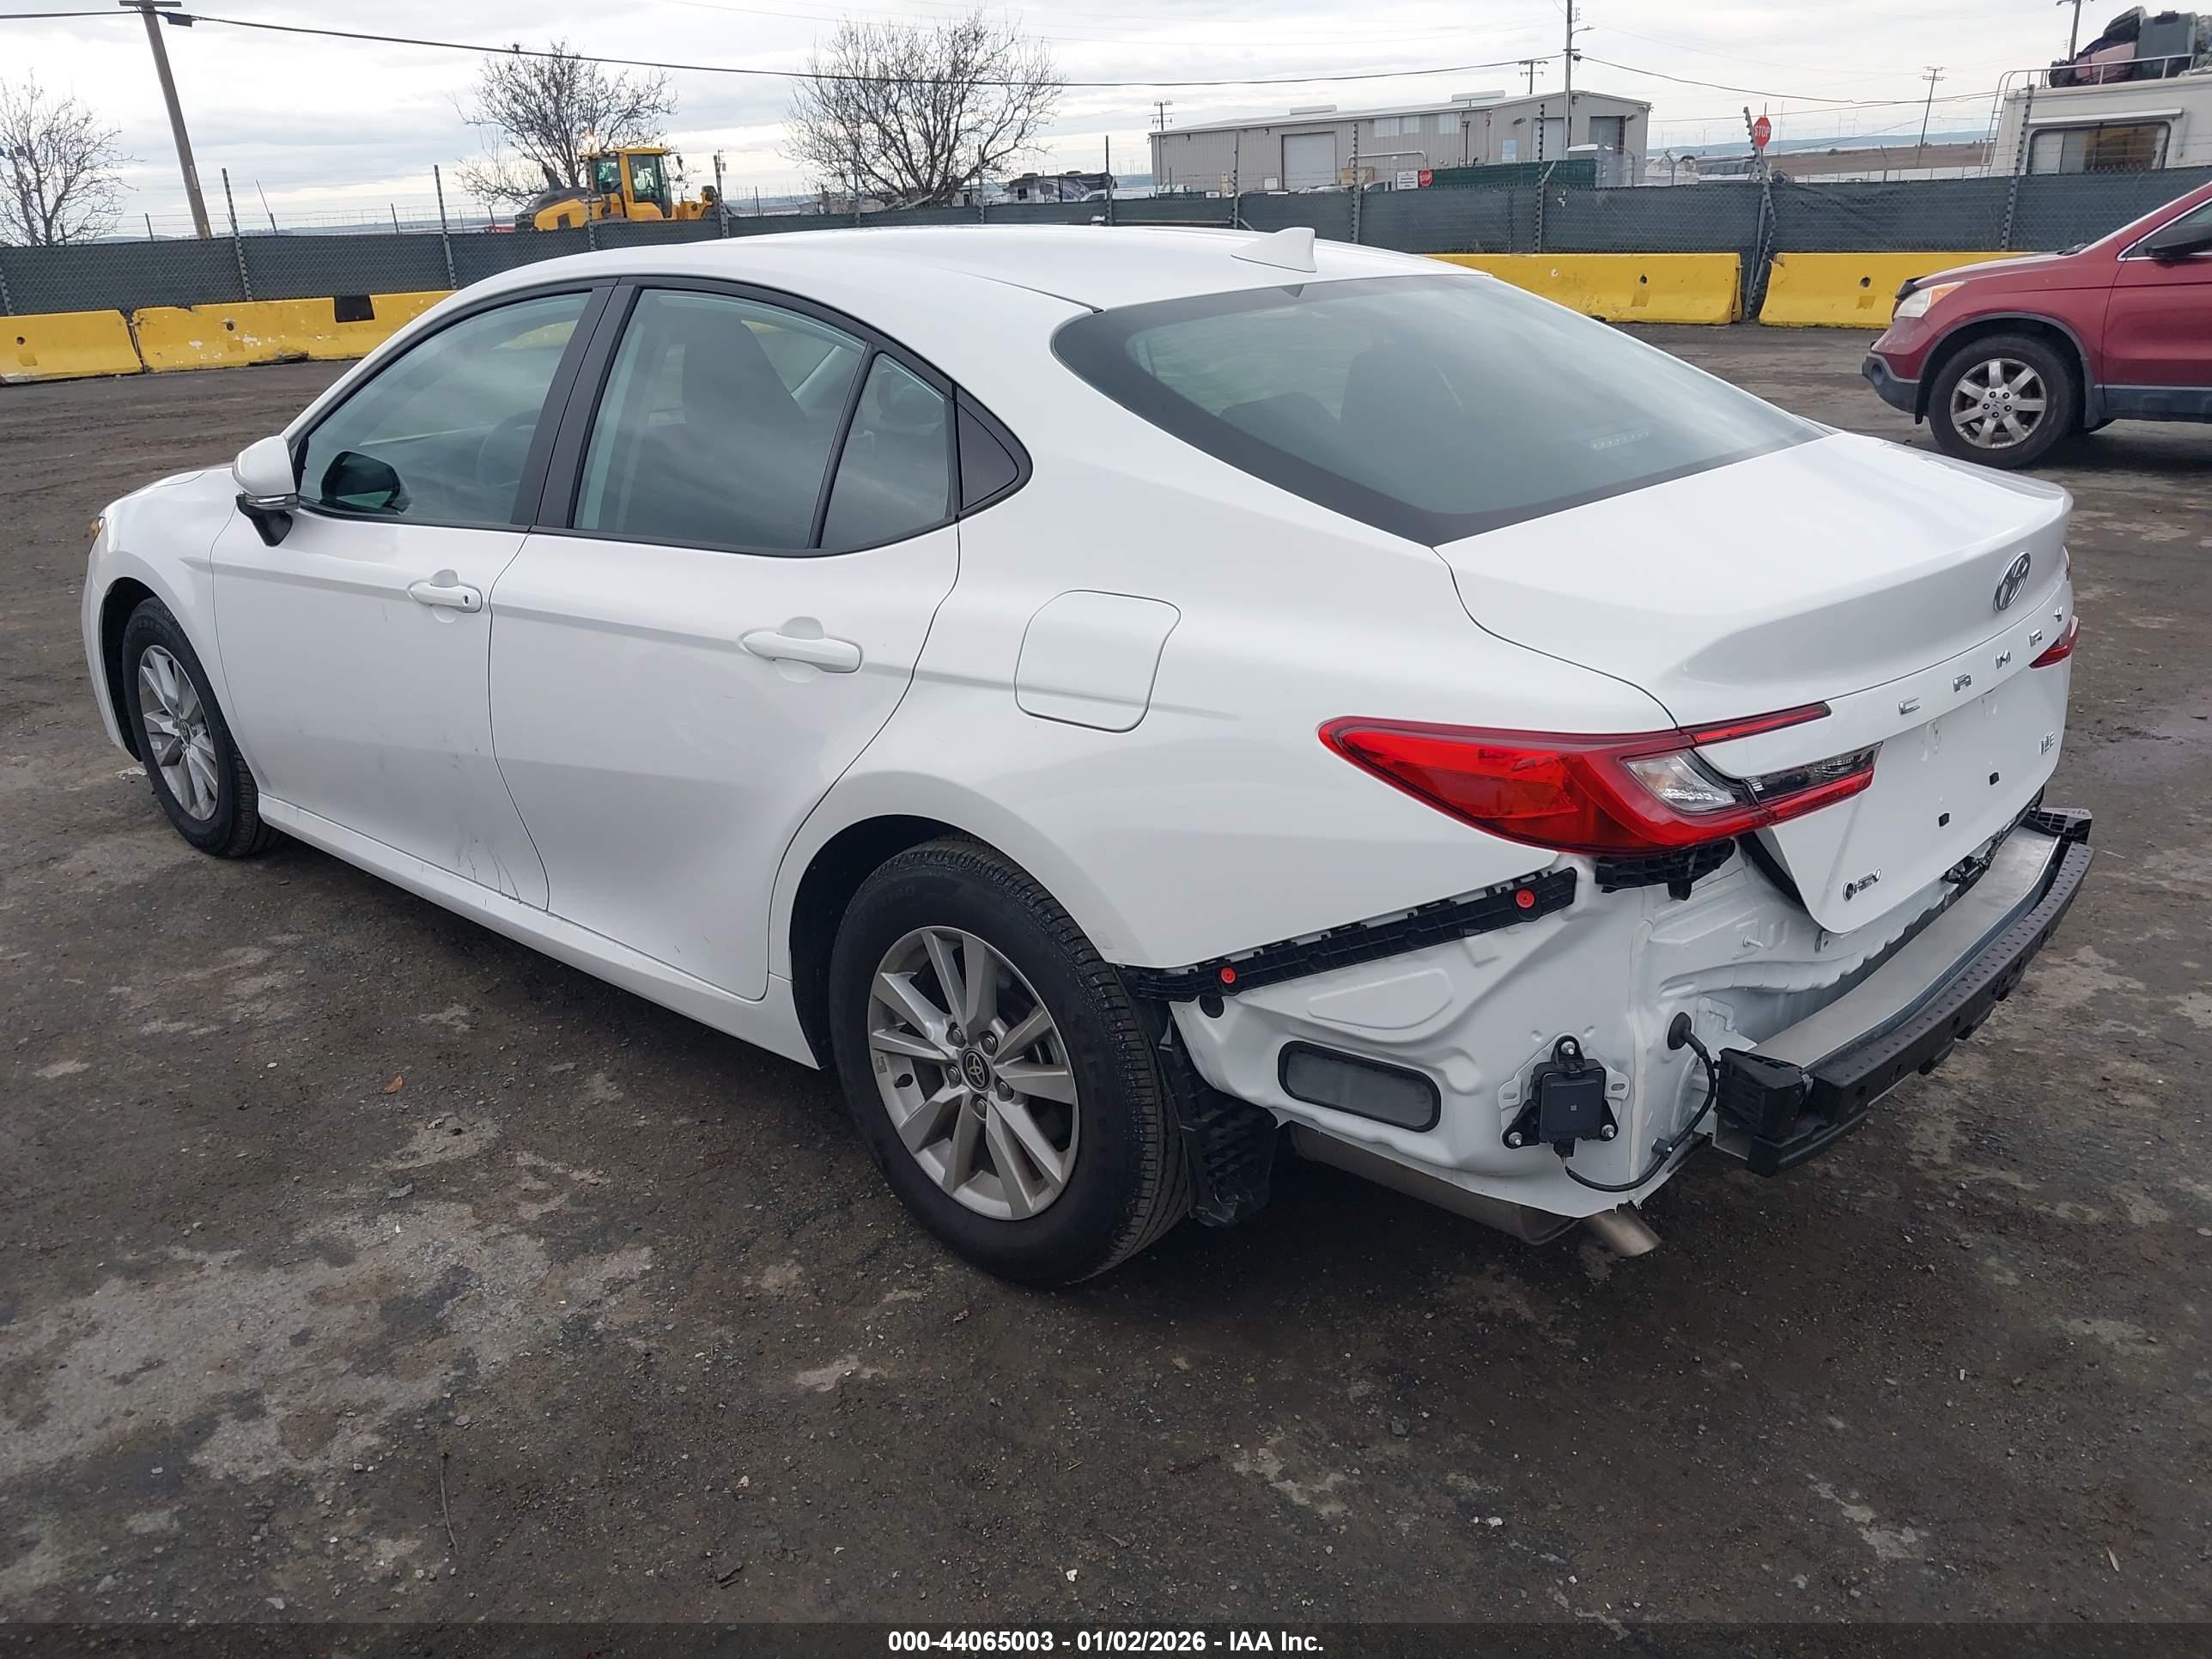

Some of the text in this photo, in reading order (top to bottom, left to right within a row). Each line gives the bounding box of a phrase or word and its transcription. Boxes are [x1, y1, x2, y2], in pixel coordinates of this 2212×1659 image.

[1754, 125, 1771, 137] STOP
[1899, 606, 2063, 716] CAMRY
[2040, 732, 2056, 756] LE
